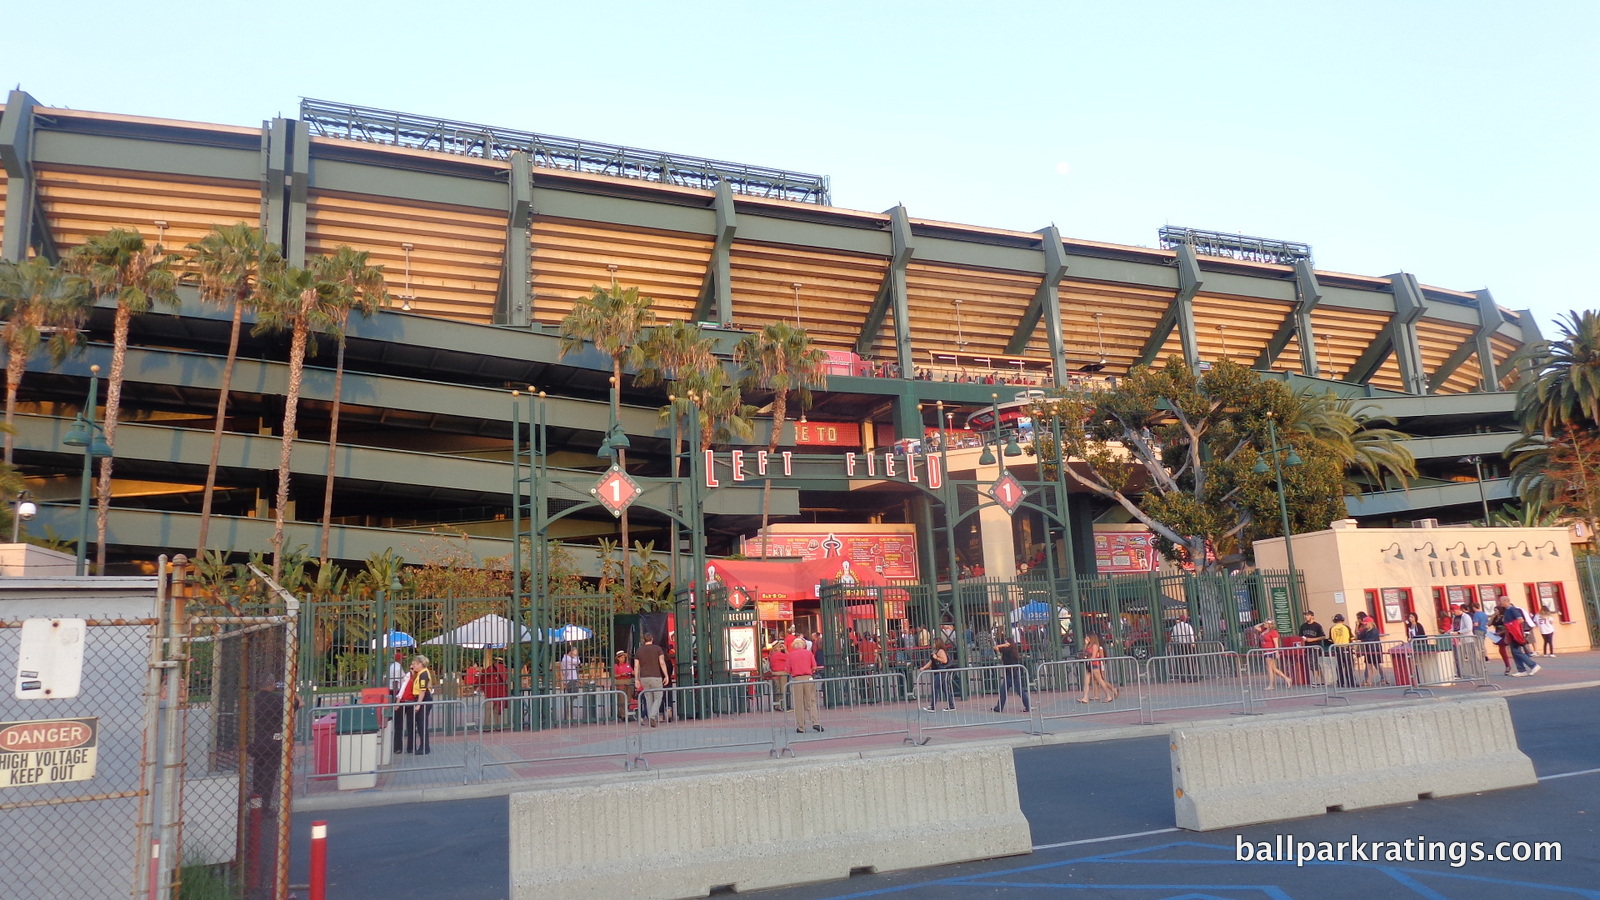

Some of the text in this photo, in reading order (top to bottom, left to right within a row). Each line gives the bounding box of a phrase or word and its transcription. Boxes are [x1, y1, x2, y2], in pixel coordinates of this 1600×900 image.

[816, 426, 837, 442] TO
[705, 449, 942, 489] LEFT FIELD
[609, 479, 620, 502] 1
[1002, 483, 1012, 502] 1
[1428, 560, 1504, 578] TICKETS
[734, 593, 740, 605] 1
[6, 726, 83, 746] DANGER
[0, 749, 89, 770] HIGH VOLTAGE
[10, 764, 76, 785] KEEP OUT
